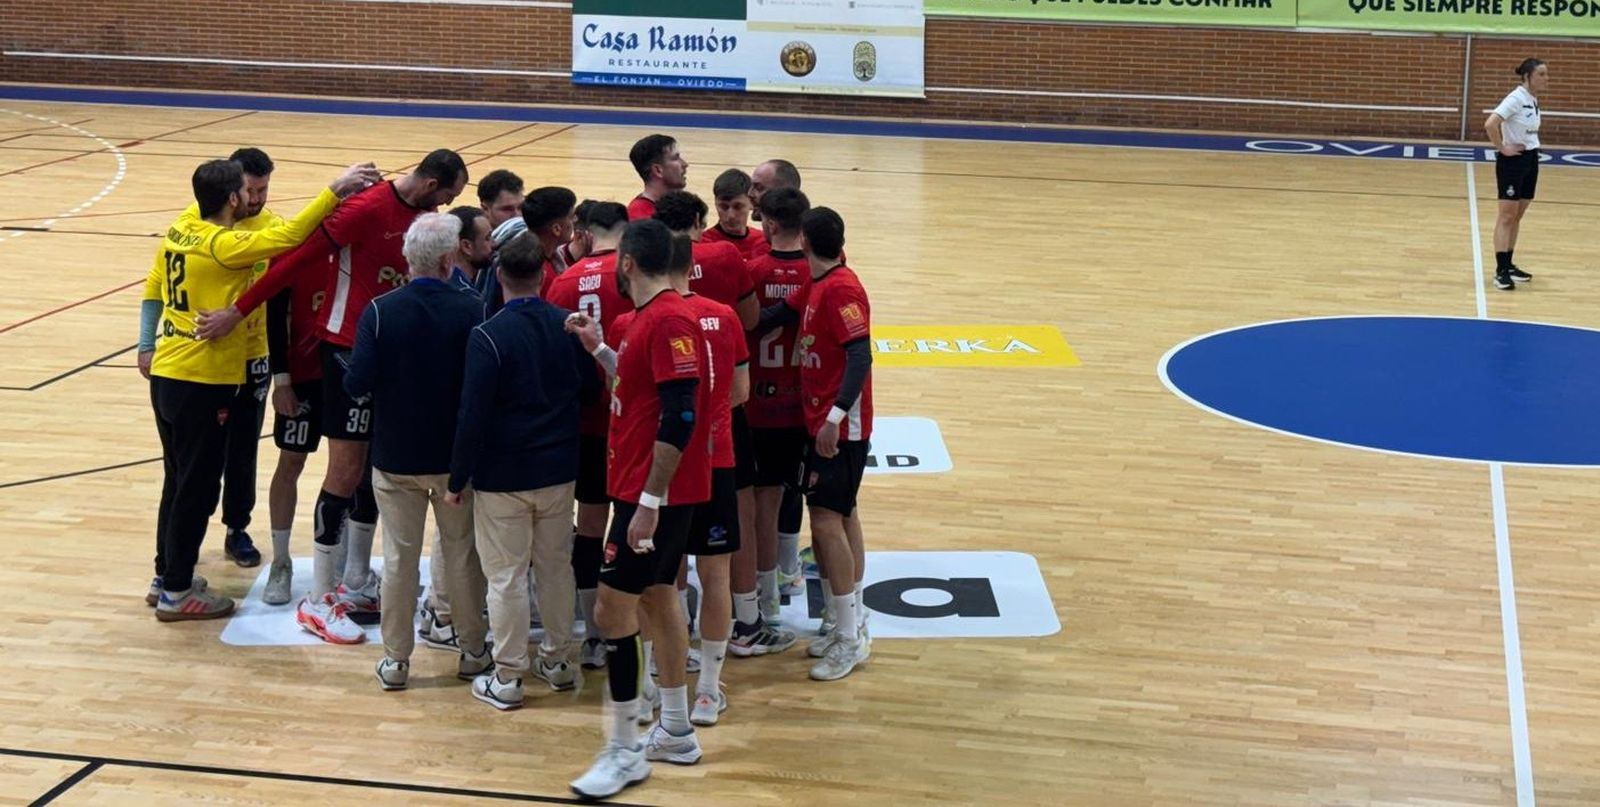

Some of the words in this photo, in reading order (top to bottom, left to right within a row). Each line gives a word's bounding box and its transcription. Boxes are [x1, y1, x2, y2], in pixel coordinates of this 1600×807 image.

[1349, 0, 1395, 13] QUE
[1403, 0, 1502, 14] SIEMPRE
[582, 23, 640, 53] Casa
[648, 25, 737, 53] Ramón
[608, 58, 708, 69] RESTAURANTE
[594, 75, 607, 83] EL
[678, 78, 724, 88] OVIEDO
[164, 250, 189, 312] 12
[765, 284, 801, 298] MOGUE
[346, 408, 370, 433] 39
[284, 420, 309, 445] 20
